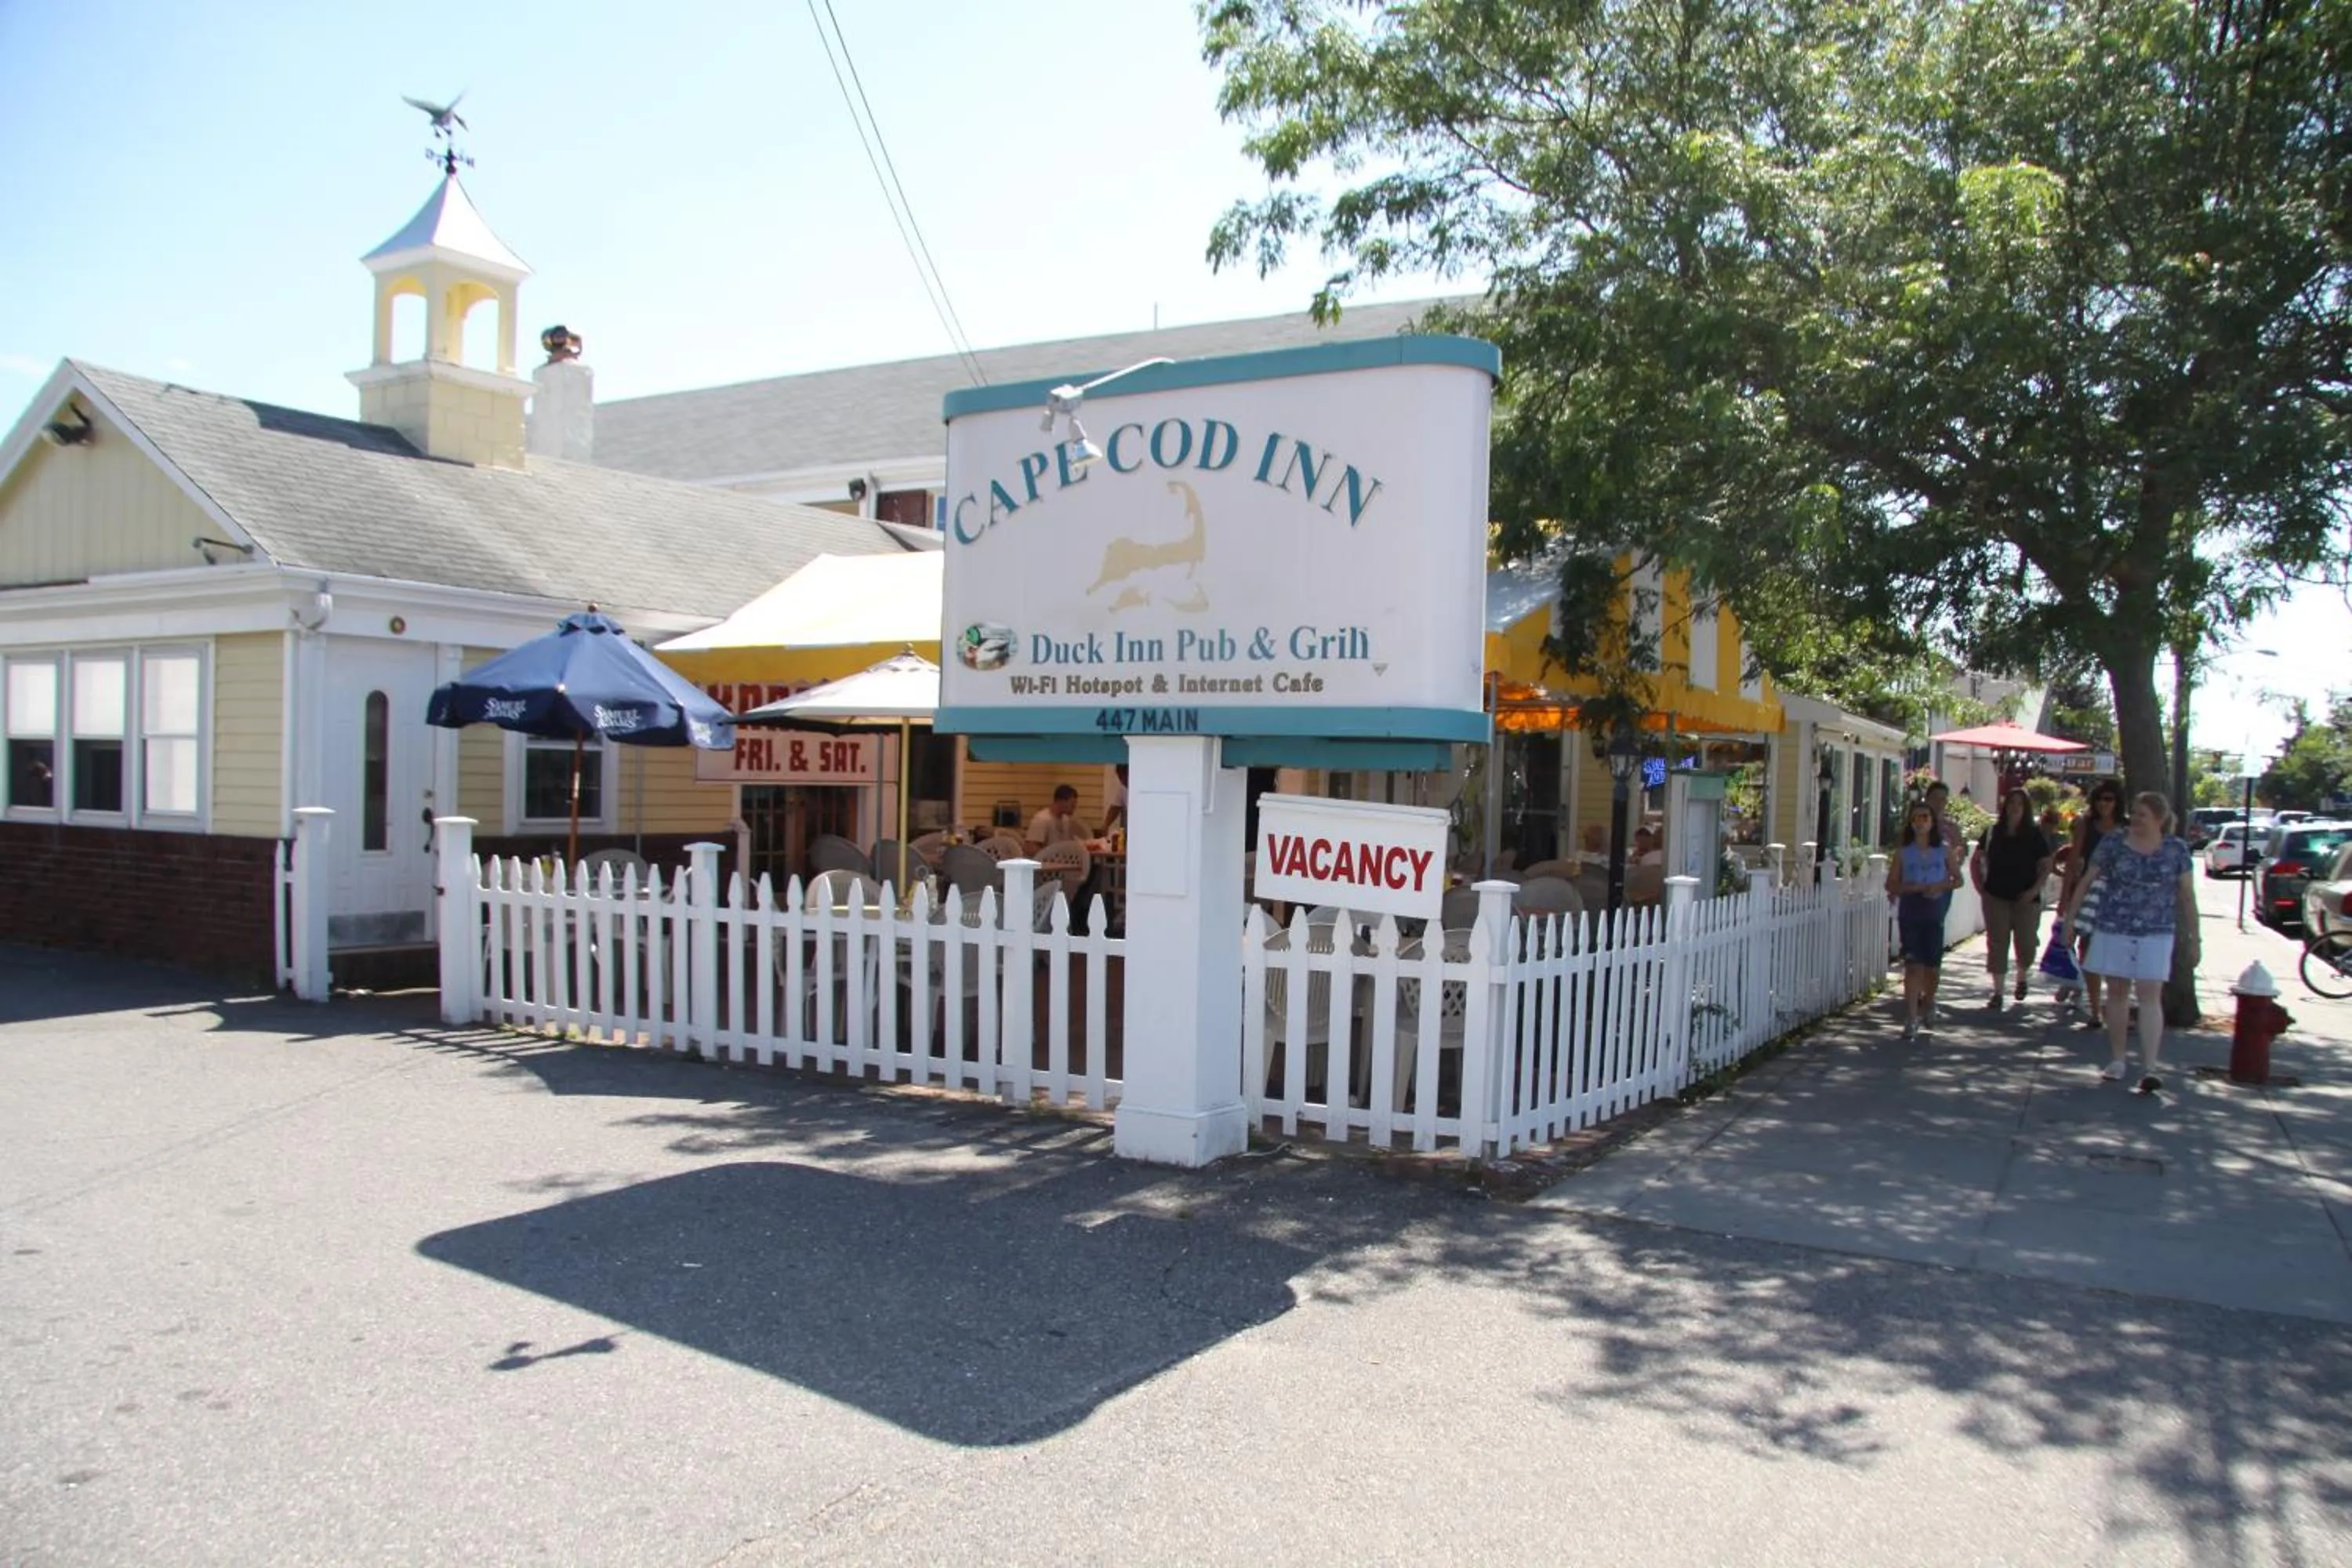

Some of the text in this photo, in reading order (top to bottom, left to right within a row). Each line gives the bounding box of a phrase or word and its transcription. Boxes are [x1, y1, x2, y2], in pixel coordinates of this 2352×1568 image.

[955, 417, 1385, 545] CAPE COD INN
[1031, 625, 1370, 665] Duck Inn Pub & Grill
[1065, 674, 1143, 698] Hotspot
[1151, 673, 1170, 693] &
[1178, 673, 1263, 694] Internet
[1272, 672, 1324, 694] Cafe
[1095, 708, 1200, 732] 447 MAIN
[735, 738, 866, 773] FRI. & SAT.
[1268, 833, 1434, 892] VACANCY
